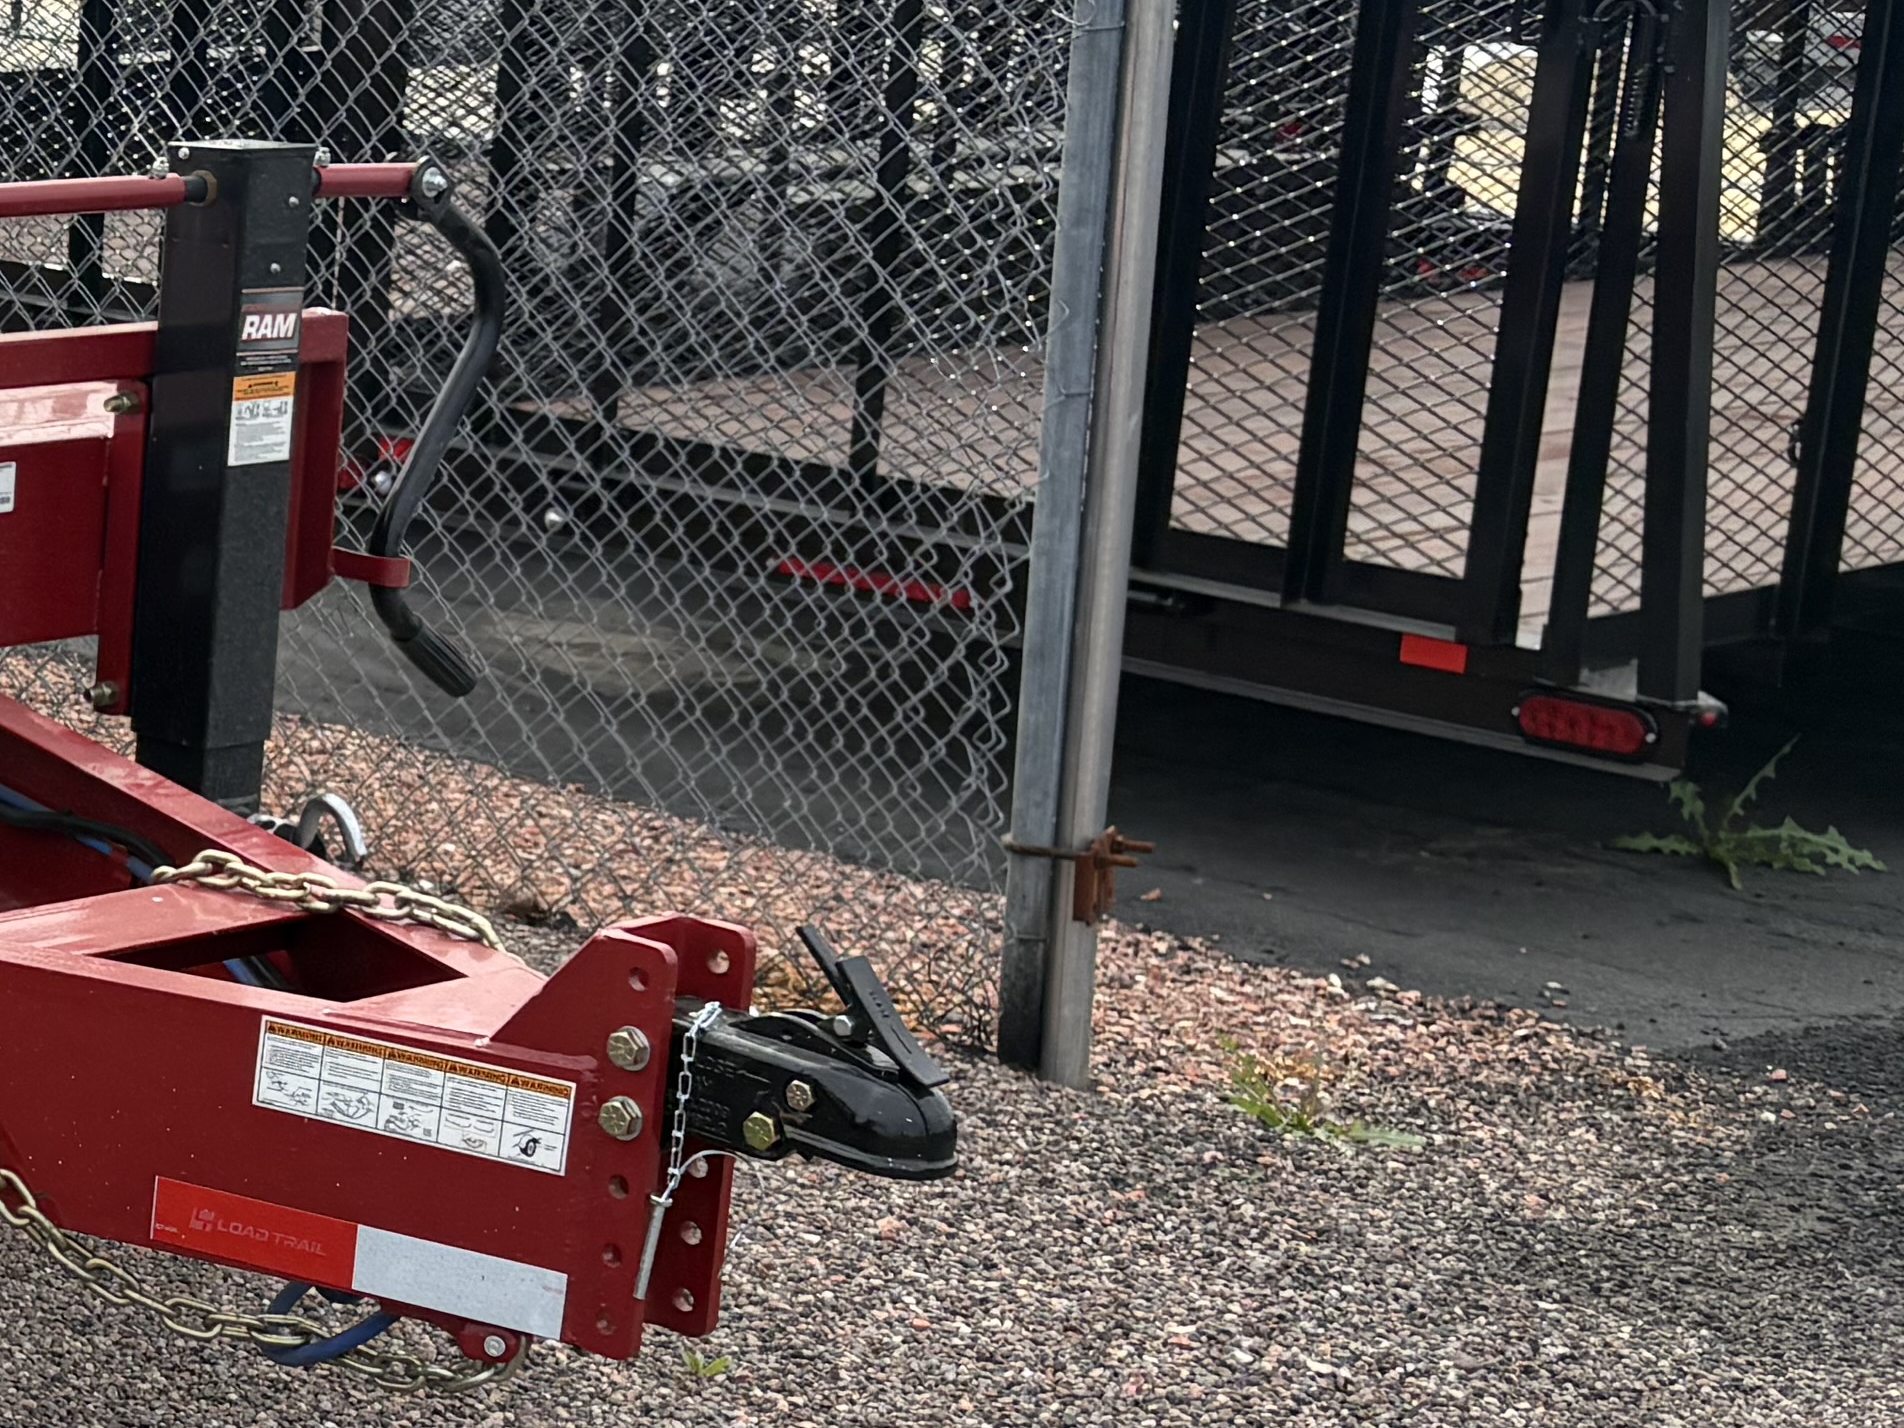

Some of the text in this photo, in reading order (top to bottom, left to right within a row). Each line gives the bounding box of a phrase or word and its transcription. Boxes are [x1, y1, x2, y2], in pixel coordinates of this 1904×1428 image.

[241, 312, 298, 340] RAM
[217, 1218, 328, 1257] LOAD TRAIL
